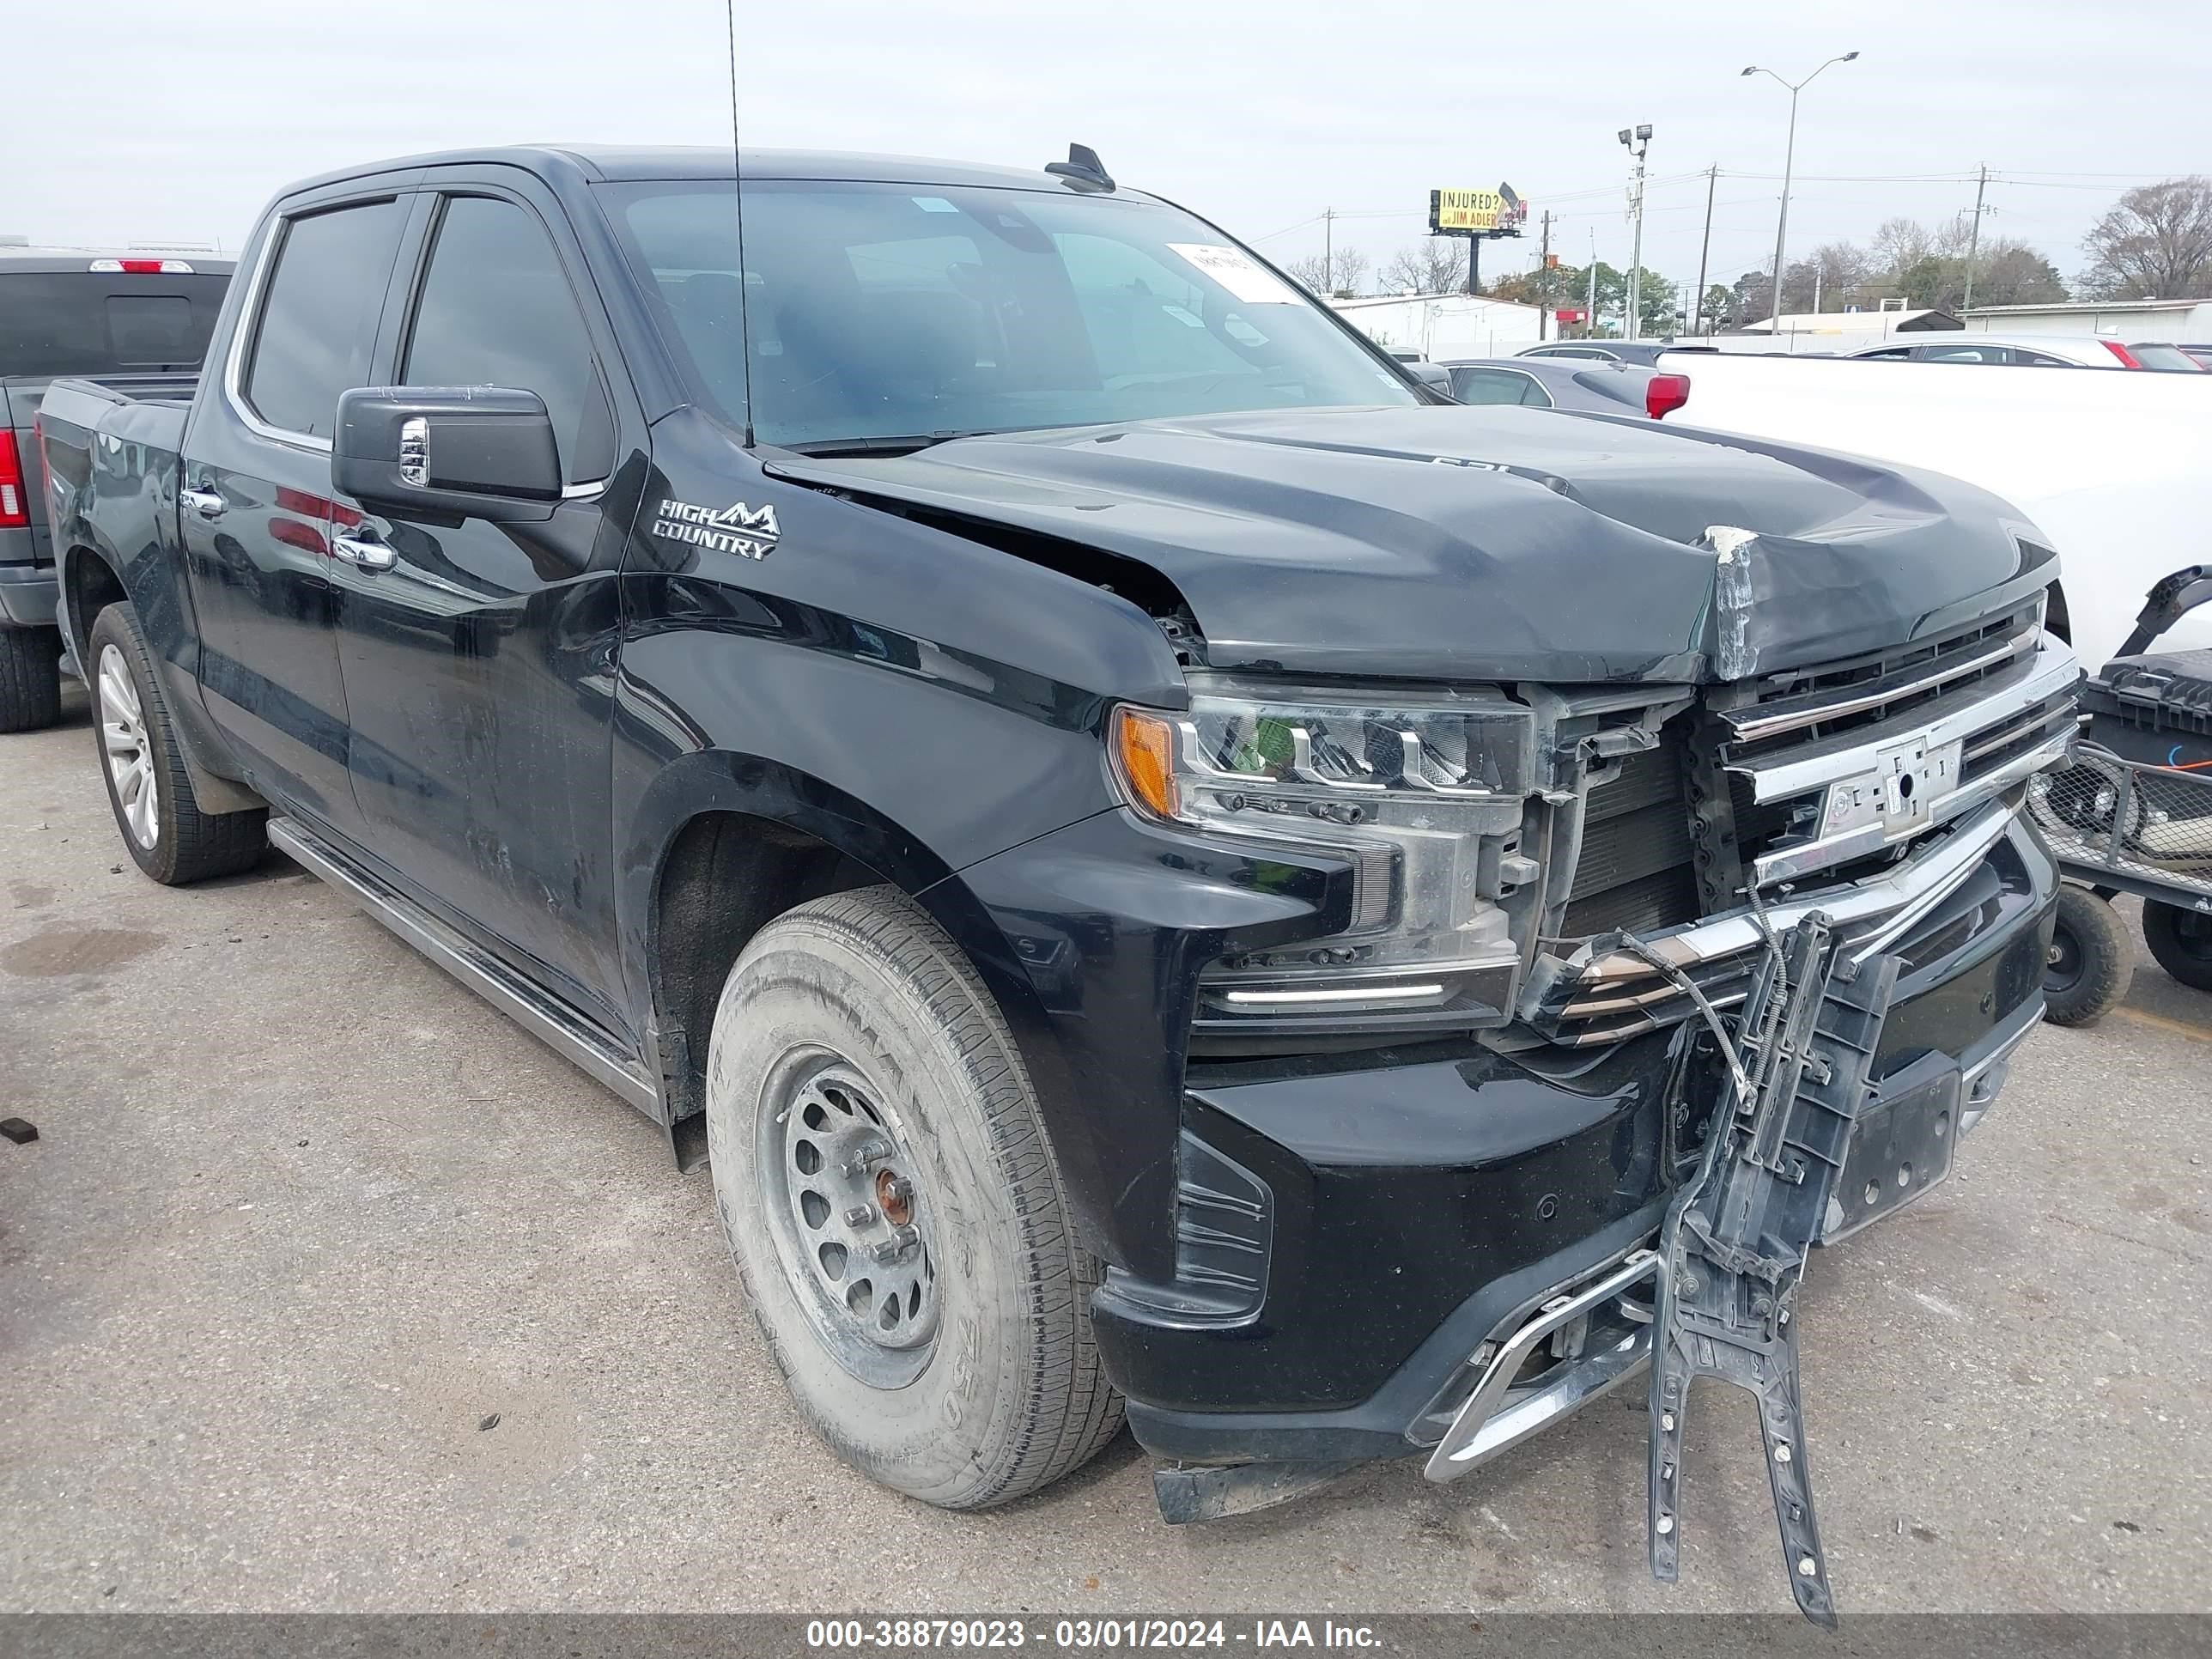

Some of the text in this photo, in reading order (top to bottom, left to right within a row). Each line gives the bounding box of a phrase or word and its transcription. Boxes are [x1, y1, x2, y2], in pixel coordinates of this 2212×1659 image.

[1443, 191, 1499, 210] INJURED?
[1452, 211, 1468, 225] JIM
[1470, 212, 1498, 228] ADLER
[658, 499, 721, 526] HIGH
[653, 519, 776, 562] COUNTRY
